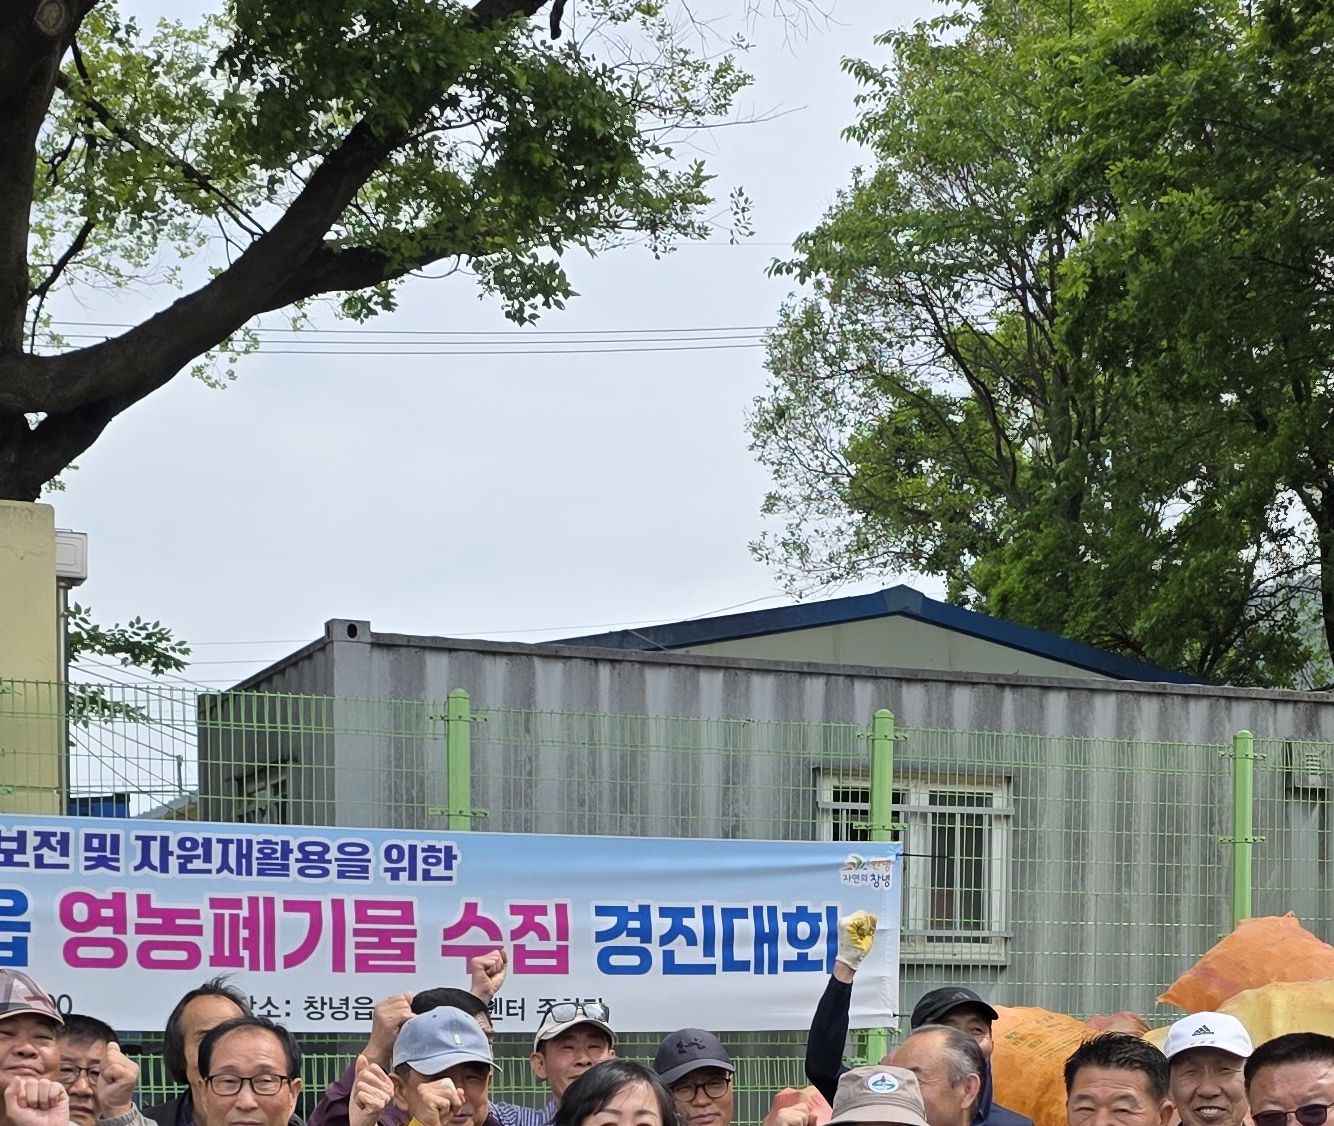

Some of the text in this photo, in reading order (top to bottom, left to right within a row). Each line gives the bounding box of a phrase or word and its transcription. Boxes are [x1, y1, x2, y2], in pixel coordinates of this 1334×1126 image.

[83, 834, 122, 872] 및
[133, 834, 372, 880] 자원재활용을
[383, 844, 458, 882] 위한
[870, 873, 891, 888] 창녕
[58, 891, 419, 974] 영농폐기물
[440, 901, 571, 975] 수집
[594, 904, 839, 976] 경진대회
[303, 995, 376, 1021] 창녕읍
